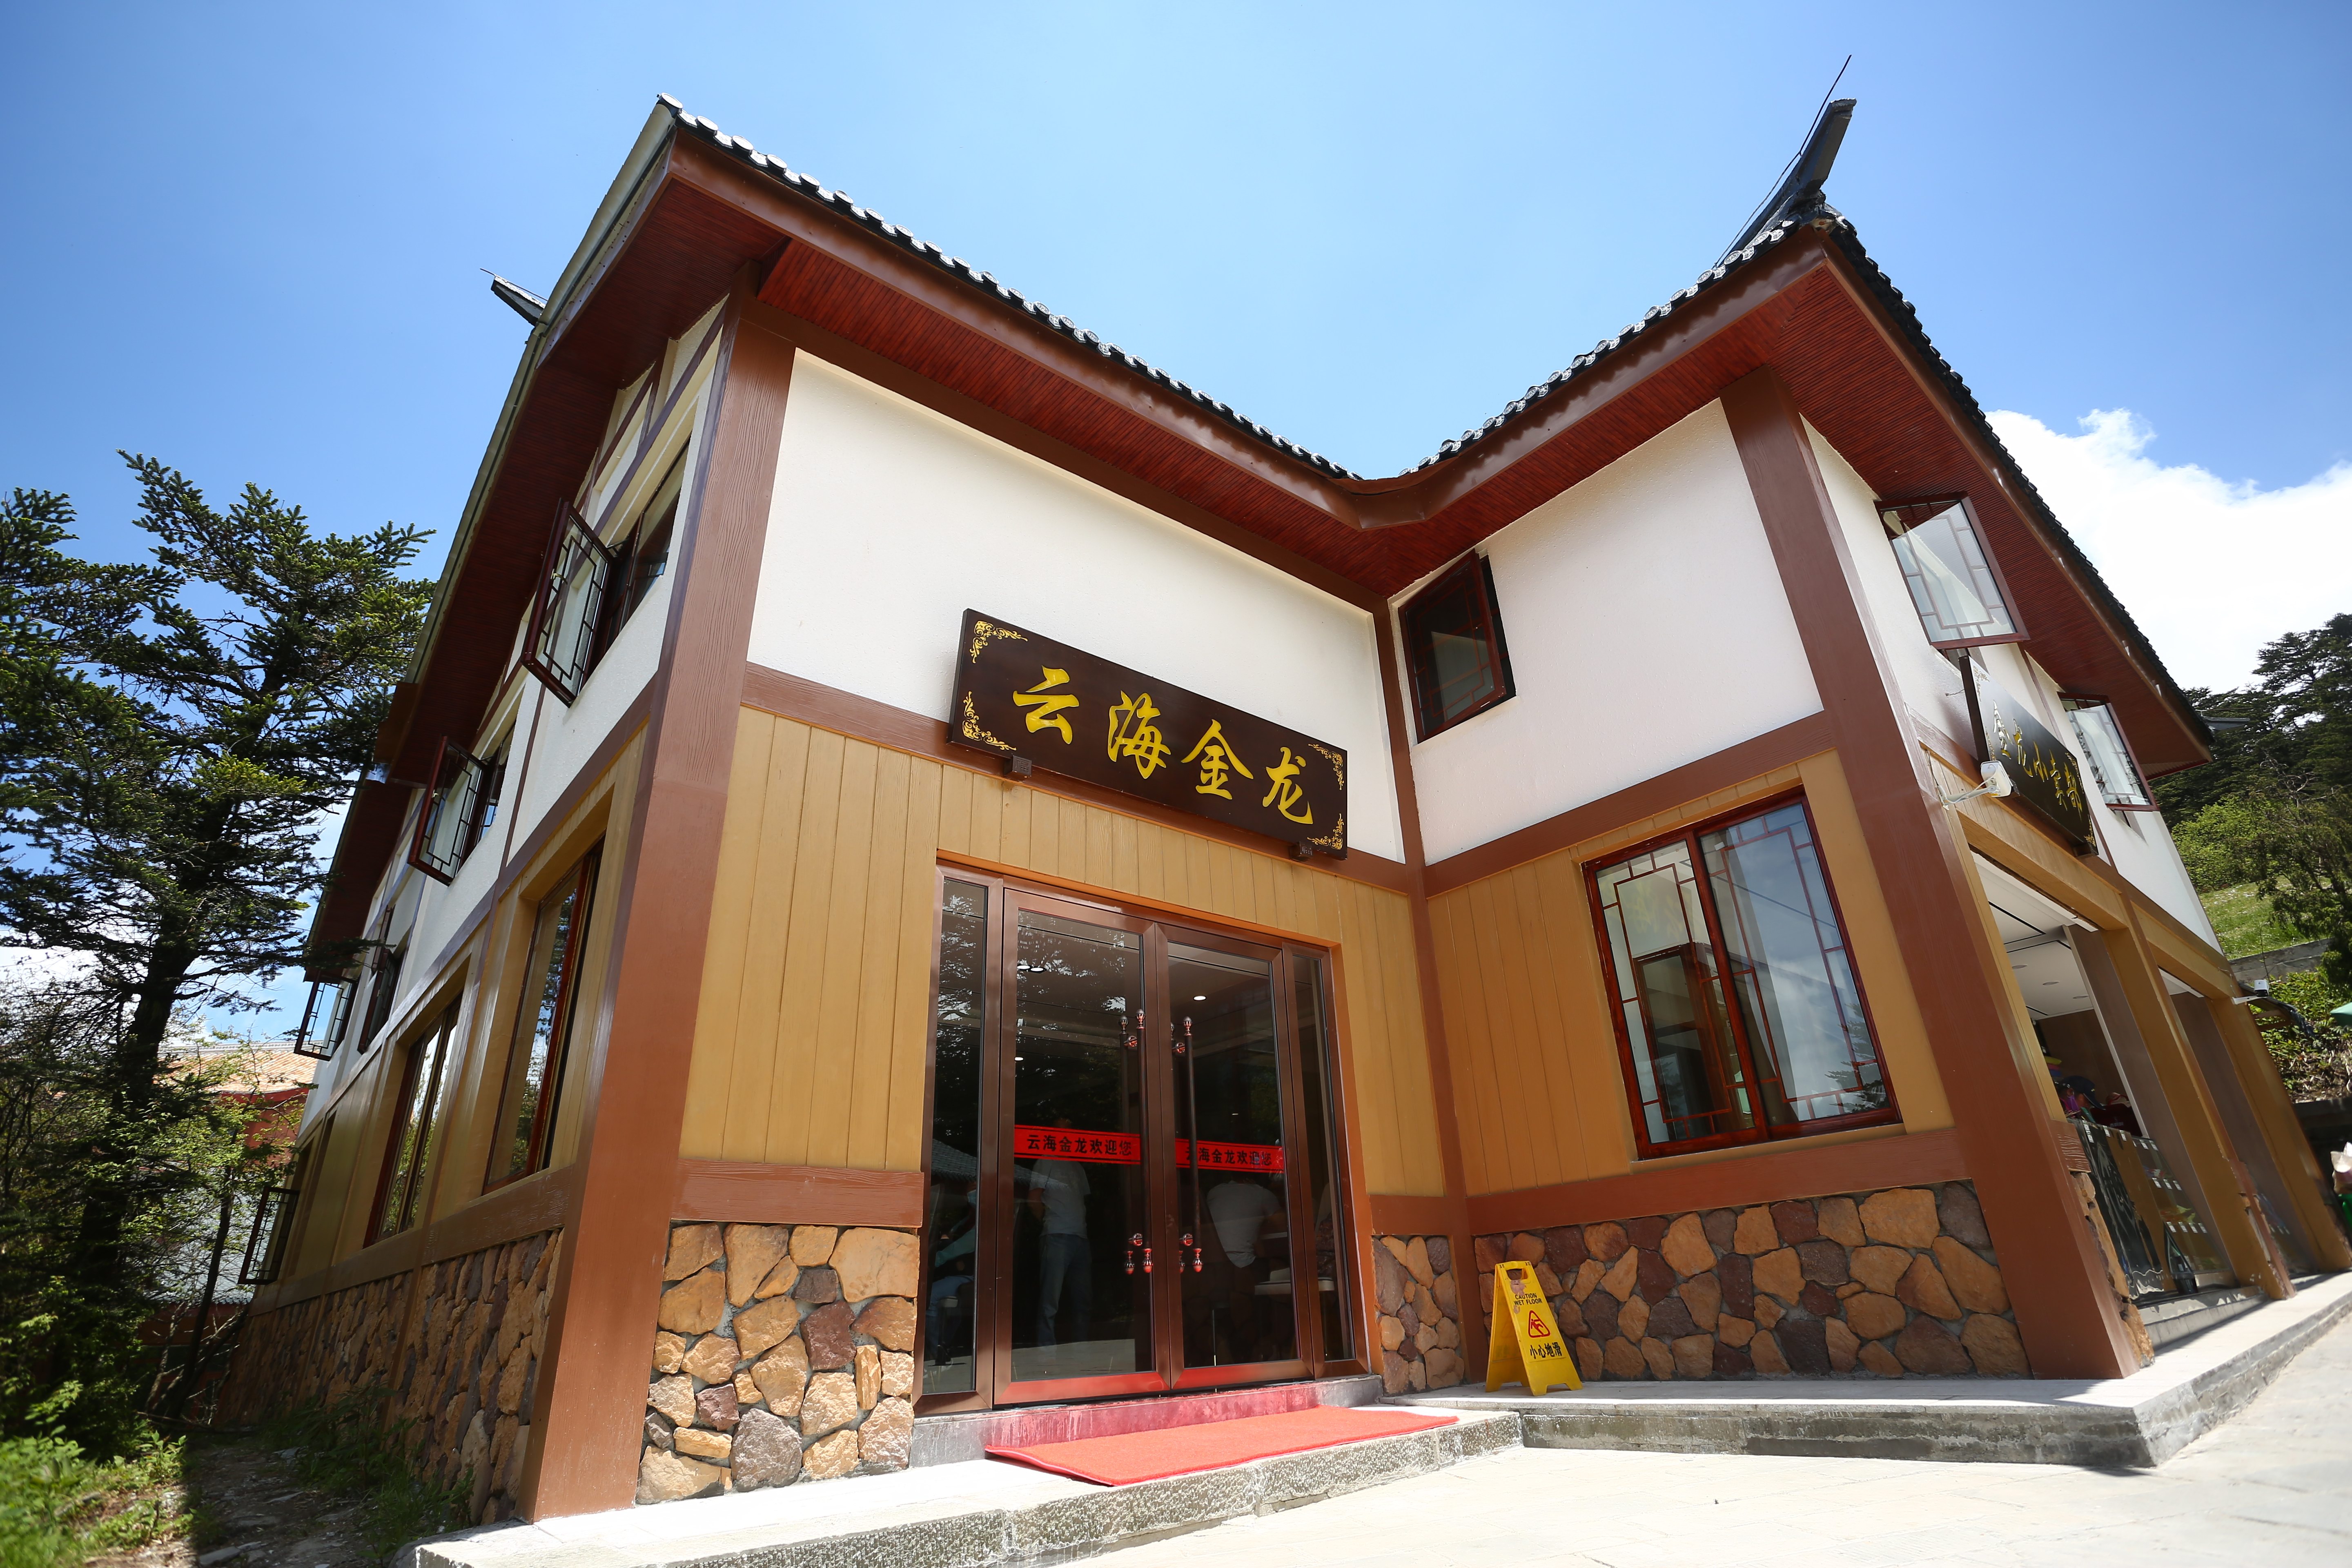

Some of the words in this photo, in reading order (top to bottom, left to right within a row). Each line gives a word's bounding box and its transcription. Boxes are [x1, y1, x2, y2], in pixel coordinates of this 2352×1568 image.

[1012, 665, 1313, 824] 云海金龙
[1993, 699, 2082, 821] 金龙小卖部
[1027, 1134, 1132, 1156] 云海金龙欢迎您
[1530, 1342, 1562, 1359] 小心地滑
